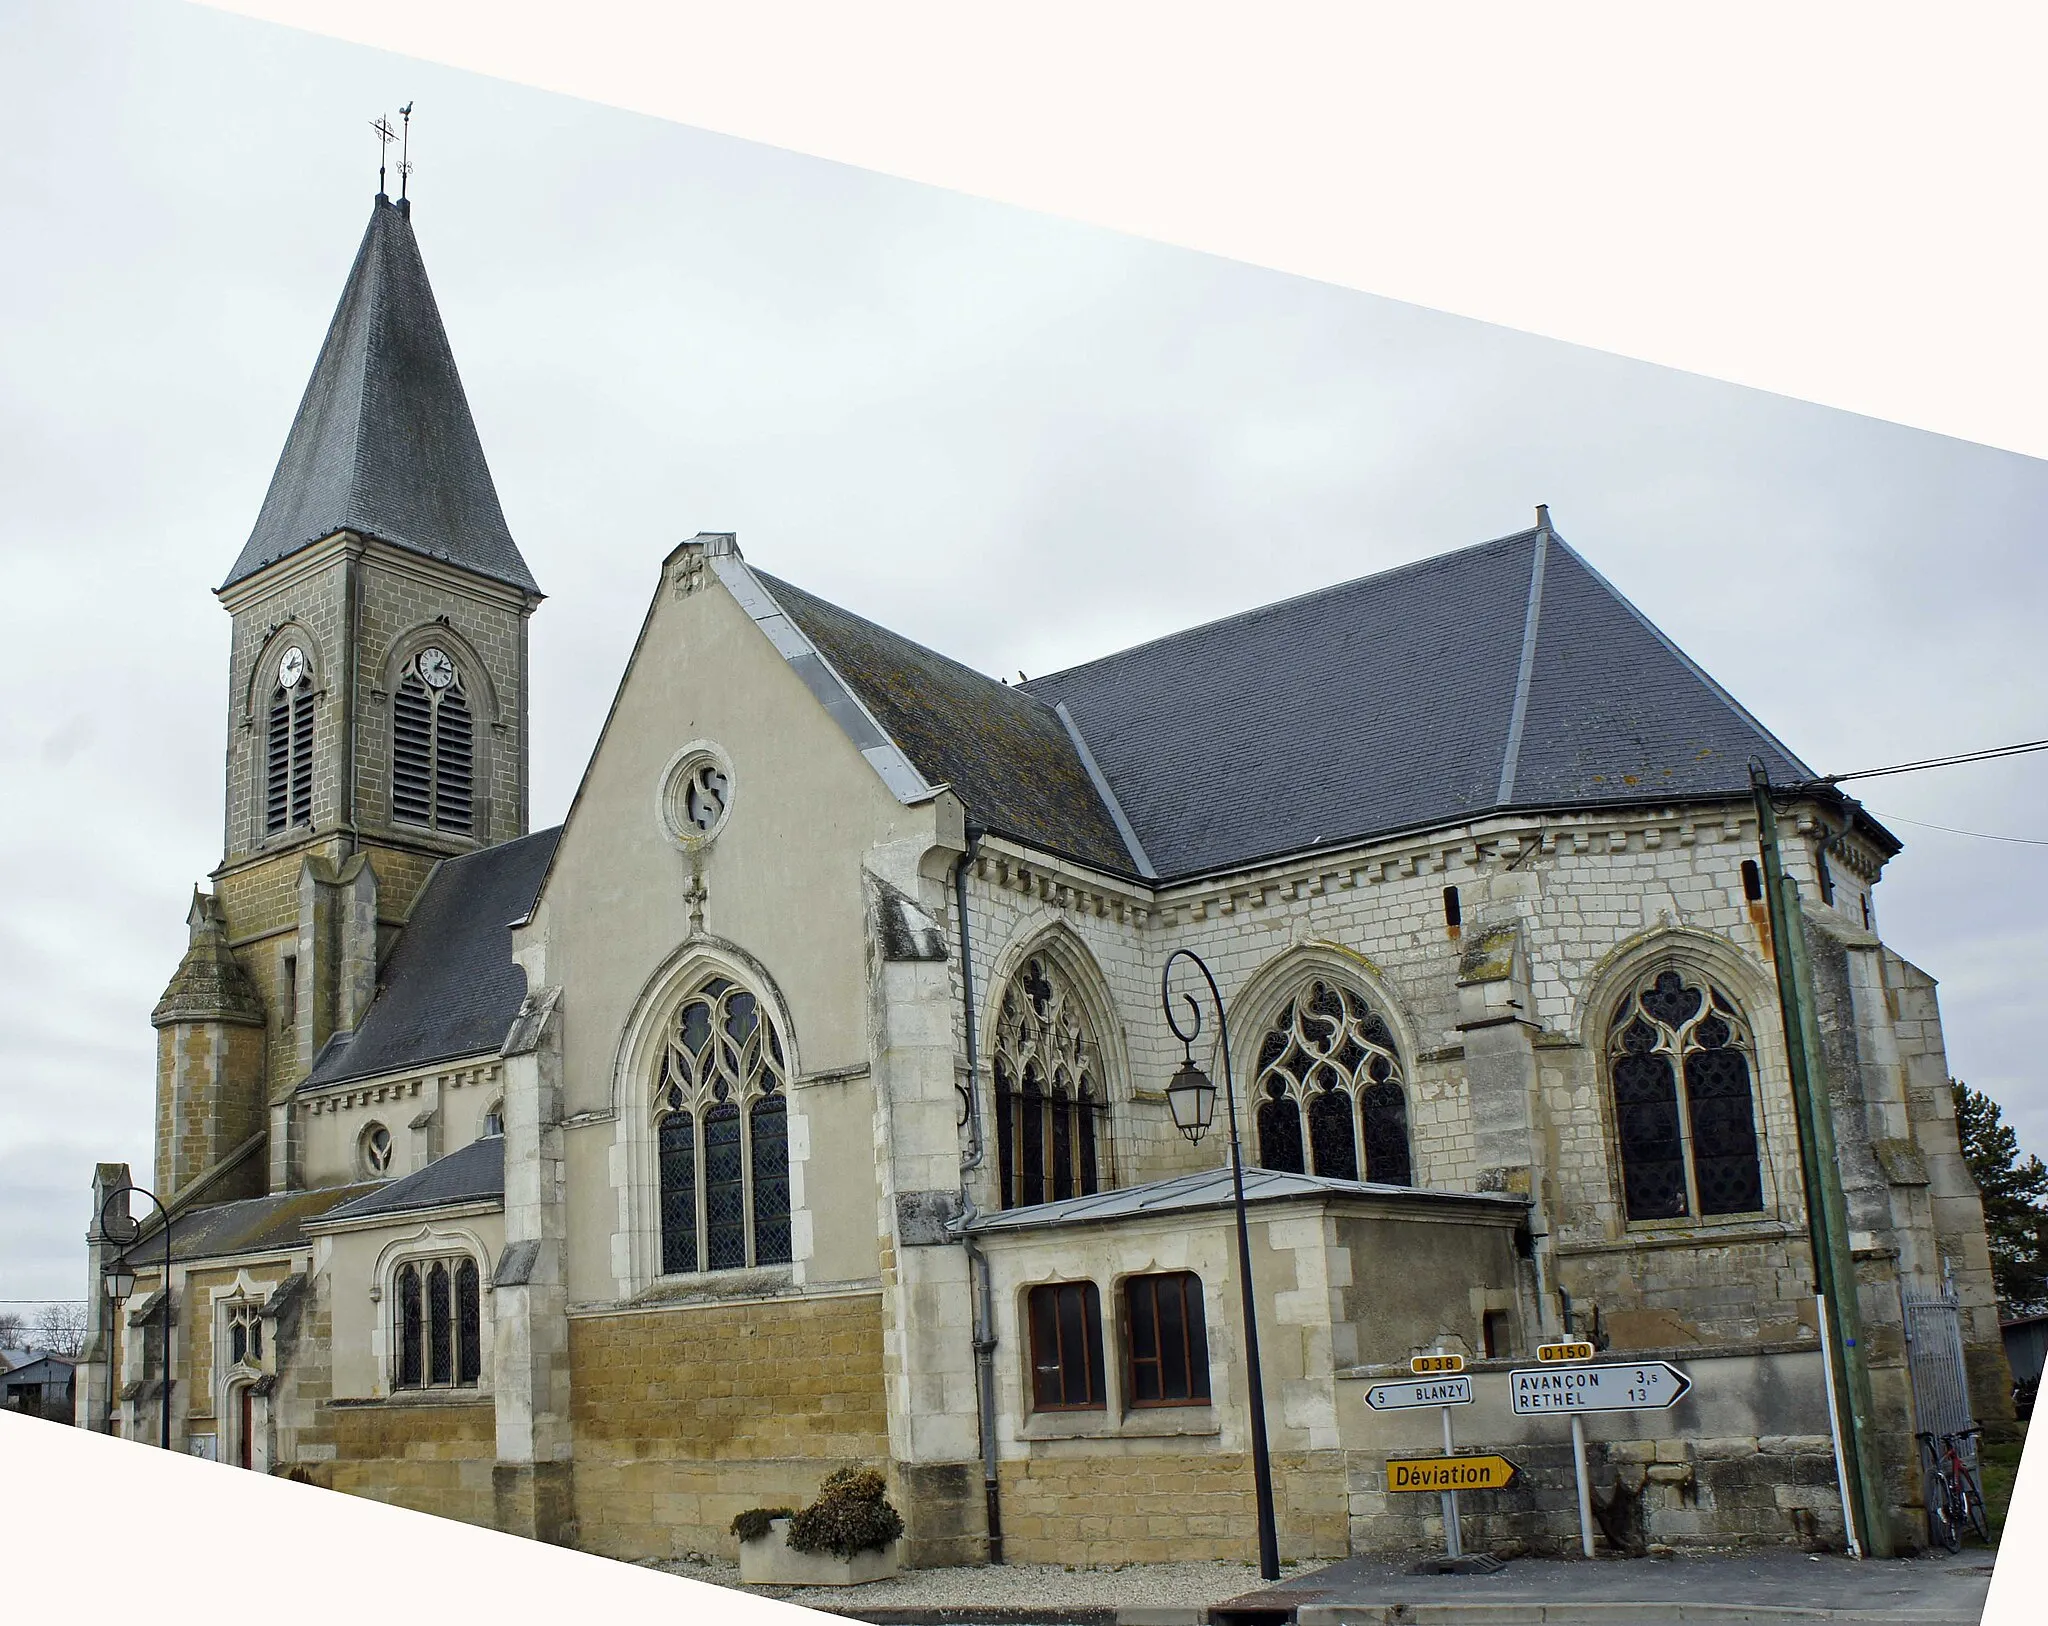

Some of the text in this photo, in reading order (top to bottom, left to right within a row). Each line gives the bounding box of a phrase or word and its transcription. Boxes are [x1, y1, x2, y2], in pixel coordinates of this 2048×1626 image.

[1544, 1345, 1587, 1360] D 150
[1421, 1357, 1454, 1371] D 38
[1520, 1370, 1658, 1390] AVANÇON 3,5
[1378, 1384, 1463, 1404] 5 BLANZY
[1520, 1388, 1647, 1408] RETHEL 13
[1396, 1464, 1490, 1486] Déviation
